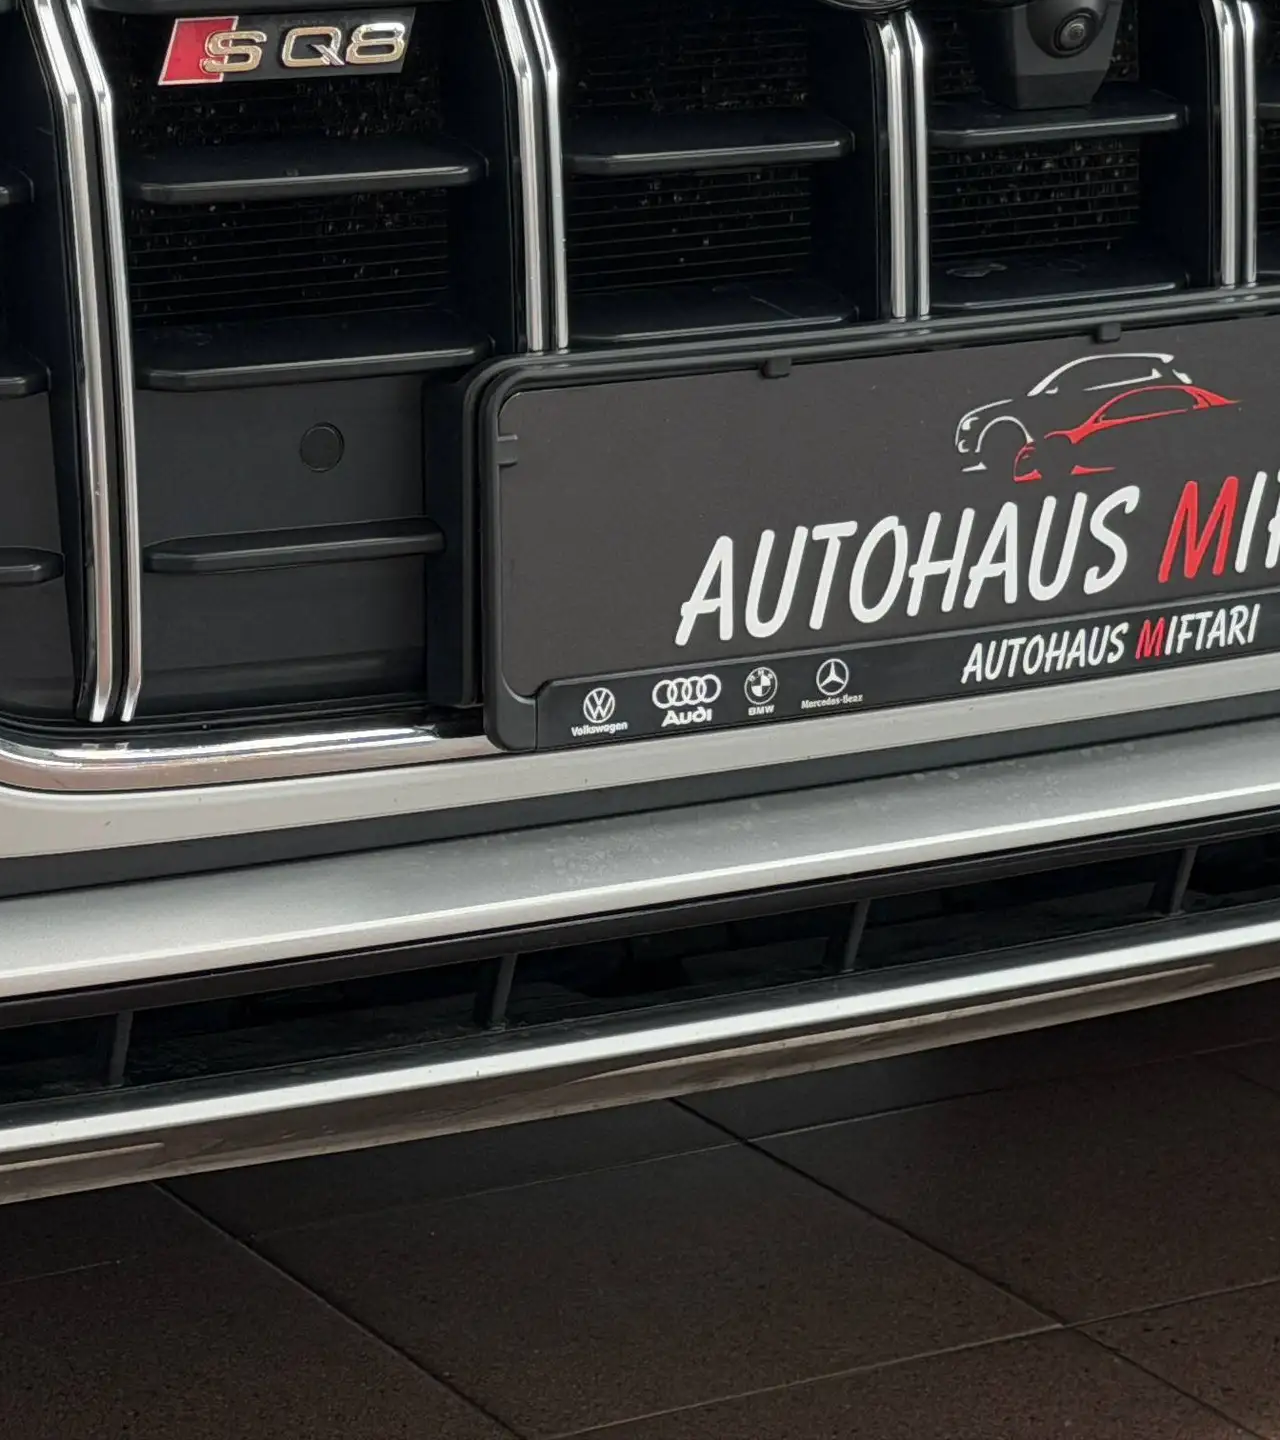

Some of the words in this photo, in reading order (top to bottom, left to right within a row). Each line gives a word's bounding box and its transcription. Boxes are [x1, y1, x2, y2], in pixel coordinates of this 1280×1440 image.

[674, 484, 1142, 647] AUTOHAUS
[960, 621, 1131, 685] AUTOHAUS
[1134, 603, 1262, 661] MIFTARI
[660, 706, 713, 728] Audi
[748, 705, 775, 716] BMW
[571, 721, 628, 737] Volkswagen
